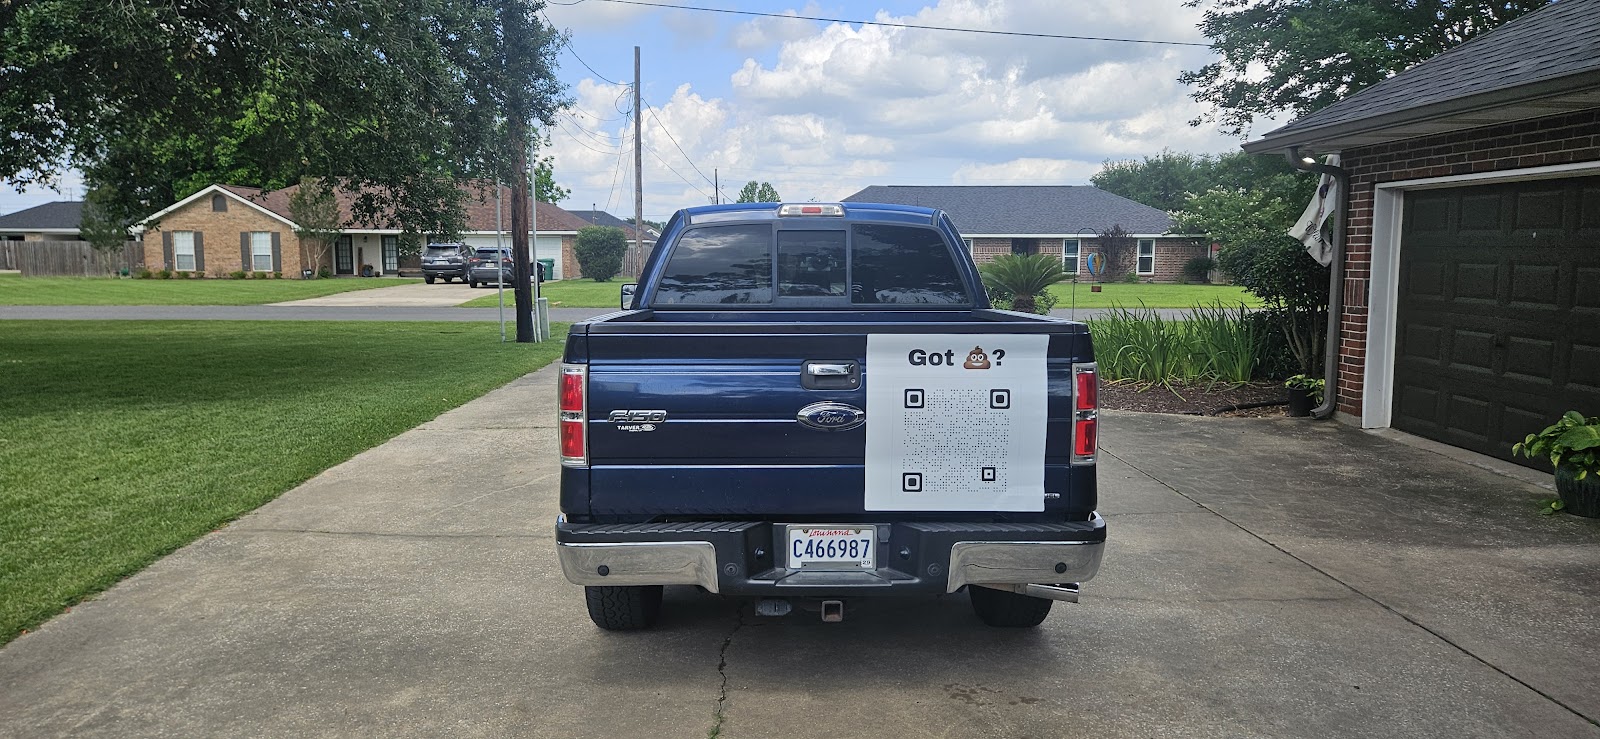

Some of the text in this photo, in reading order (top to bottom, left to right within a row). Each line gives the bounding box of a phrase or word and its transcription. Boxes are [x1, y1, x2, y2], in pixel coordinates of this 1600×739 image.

[908, 349, 954, 366] Got
[817, 411, 846, 423] Ford
[793, 539, 870, 558] C466987
